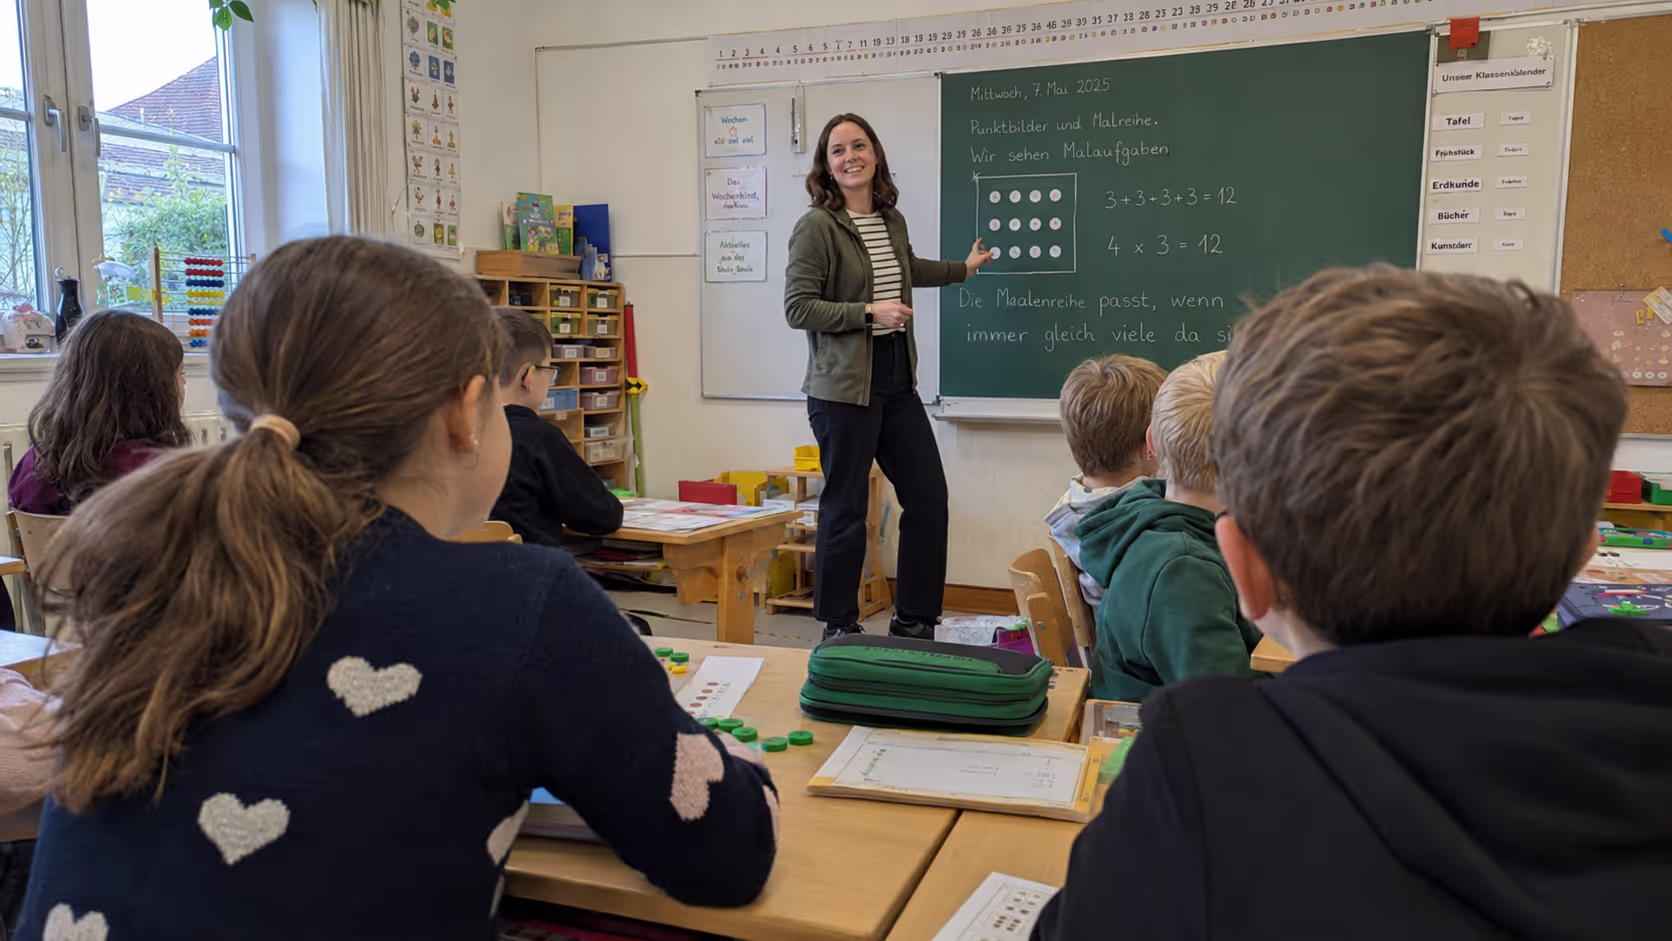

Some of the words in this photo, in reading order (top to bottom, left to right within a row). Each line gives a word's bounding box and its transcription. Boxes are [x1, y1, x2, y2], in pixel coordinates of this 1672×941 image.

[969, 85, 1028, 101] Mittwoch,
[1032, 82, 1043, 97] 7.
[1046, 81, 1069, 96] Mai
[1076, 77, 1111, 94] 2025
[969, 119, 1049, 135] Punktbilder
[1056, 115, 1082, 131] und
[1092, 111, 1159, 129] Malreihe.
[1445, 116, 1471, 126] Tafel
[969, 146, 996, 164] Wir
[1008, 147, 1050, 162] sehen
[1435, 149, 1475, 158] Frühstück
[1432, 179, 1480, 190] Erdkunde
[1437, 210, 1470, 220] Bücher
[1107, 235, 1121, 256] 4
[1156, 234, 1170, 255] 3
[1198, 233, 1224, 255] 12
[958, 287, 983, 308] Die
[1099, 291, 1157, 317] passt,
[1170, 295, 1224, 308] wenn
[966, 323, 1028, 343] immer
[1044, 322, 1095, 352] gleich
[1111, 323, 1156, 343] viele
[1174, 322, 1202, 343] da
